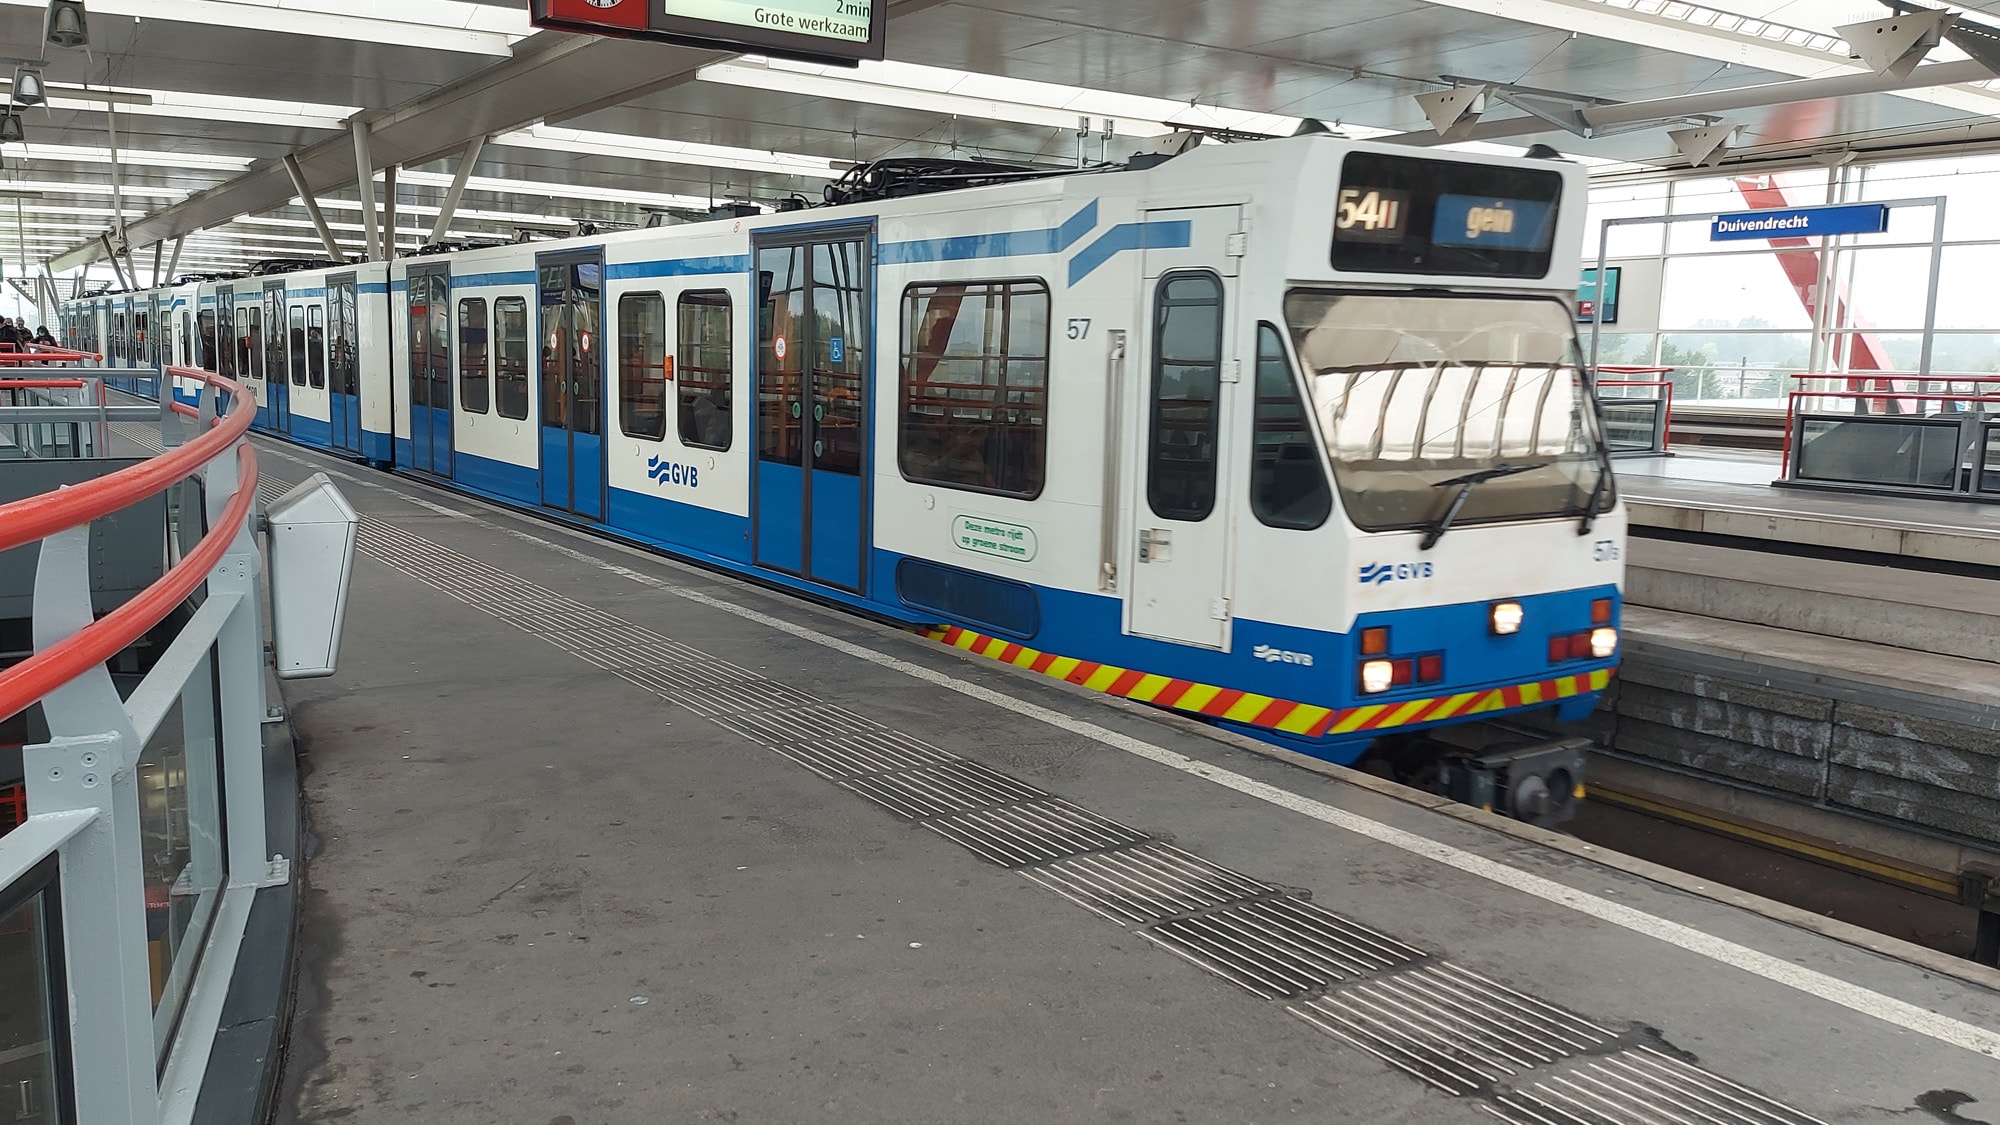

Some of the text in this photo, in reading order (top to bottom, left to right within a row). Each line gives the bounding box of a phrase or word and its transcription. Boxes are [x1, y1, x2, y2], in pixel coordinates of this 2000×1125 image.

[836, 0, 870, 18] 2 min
[754, 8, 868, 38] Grote werkzaam
[1718, 215, 1809, 232] Duivendrecht
[1067, 318, 1091, 340] 57
[672, 463, 698, 488] GVB
[964, 520, 1024, 541] Deze metro rijdt
[961, 536, 1026, 556] op groene stroom
[1397, 562, 1433, 580] GVB
[1282, 650, 1314, 667] GVB
